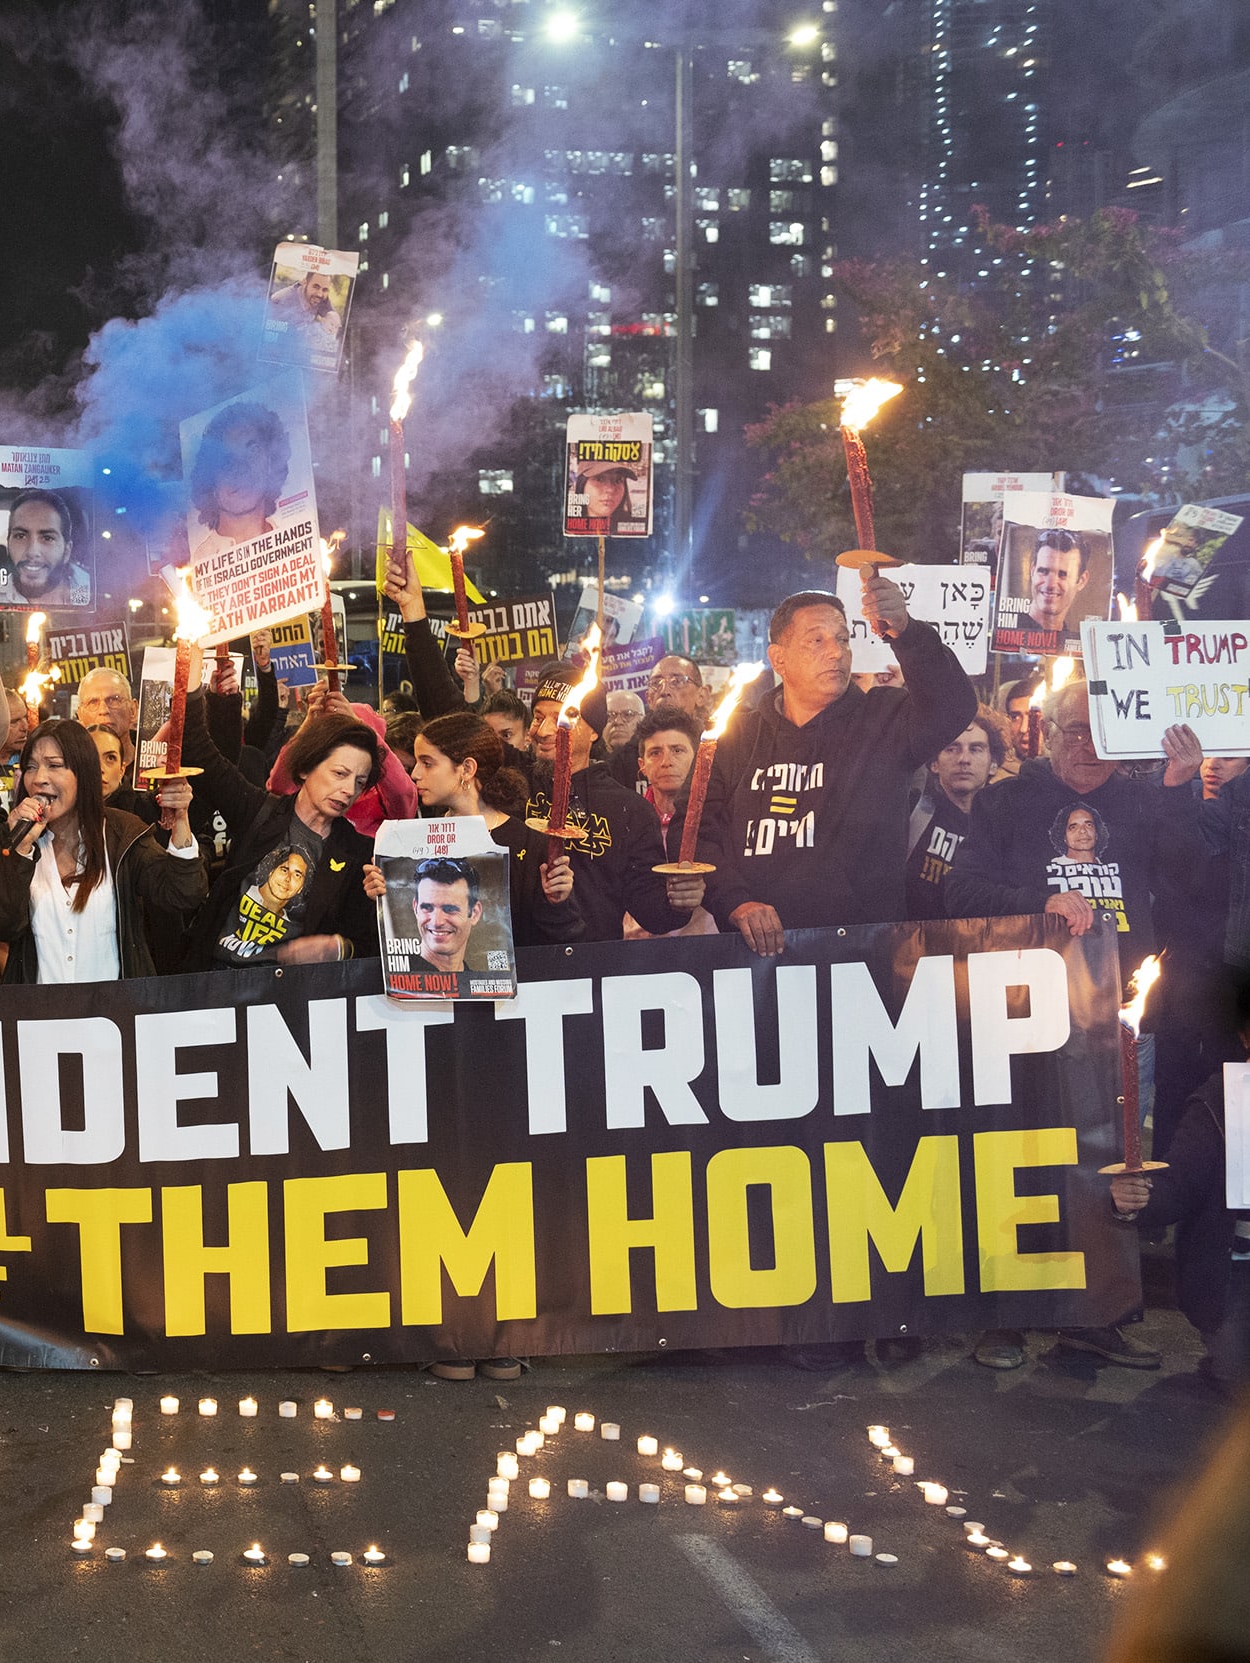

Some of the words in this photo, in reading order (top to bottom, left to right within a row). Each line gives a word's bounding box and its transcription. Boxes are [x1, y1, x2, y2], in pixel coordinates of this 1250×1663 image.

[579, 442, 603, 460] מיד!
[605, 442, 640, 462] עסקה
[1, 463, 23, 472] MATAN
[24, 464, 61, 475] ZANGAUKER
[568, 493, 589, 505] BRING
[568, 505, 582, 517] HER
[195, 561, 209, 578] MY
[211, 551, 235, 572] LIFE
[236, 547, 243, 562] IS
[243, 544, 250, 559] IN
[251, 536, 273, 555] THE
[274, 521, 313, 547] HANDS
[964, 552, 987, 562] BRING
[213, 561, 250, 585] ISRAELI
[250, 536, 314, 571] GOVERNMENT
[207, 585, 230, 603] THEY
[231, 574, 257, 594] DON'T
[258, 566, 280, 583] SIGN
[281, 562, 289, 576] A
[290, 553, 316, 572] DEAL
[229, 590, 252, 611] ARE
[253, 573, 298, 601] SIGNING
[299, 565, 316, 585] MY
[208, 609, 244, 635] EATH
[247, 580, 319, 622] WARRANT!
[999, 597, 1031, 613] BRING
[512, 600, 551, 630] אתם
[997, 613, 1018, 628] HIM
[90, 629, 124, 654] אתם
[270, 624, 305, 644] החט
[527, 627, 554, 657] הם
[996, 630, 1025, 645] HOME
[1027, 630, 1057, 648] NOW!
[49, 633, 89, 659] בבית
[470, 632, 525, 665] בעזה
[1106, 633, 1150, 671] IN
[1164, 633, 1247, 665] TRUMP
[270, 654, 308, 671] האחר
[616, 652, 630, 660] את
[544, 679, 555, 689] ALL
[538, 688, 558, 699] HOME
[556, 690, 568, 703] NO
[1111, 689, 1151, 720] WE
[1166, 683, 1248, 718] TRUST
[141, 740, 168, 755] BRING
[139, 754, 157, 768] HER
[428, 823, 439, 833] אור
[442, 823, 455, 833] דרור
[427, 834, 445, 844] DROR
[446, 834, 456, 844] OR
[434, 845, 449, 856] (48)
[1046, 863, 1062, 876] לי
[1065, 862, 1119, 877] קוראים
[1047, 876, 1123, 898] עופר
[239, 894, 287, 933] DEAL
[386, 938, 421, 955] BRING
[388, 955, 410, 972] HIM
[390, 974, 421, 991] HOME
[425, 974, 458, 991] NOW!
[470, 985, 493, 993] FAMILIES
[494, 985, 513, 993] FORUM
[495, 947, 1070, 1135] TRUMP
[46, 1161, 538, 1338] THEM
[587, 1127, 1087, 1315] HOME
